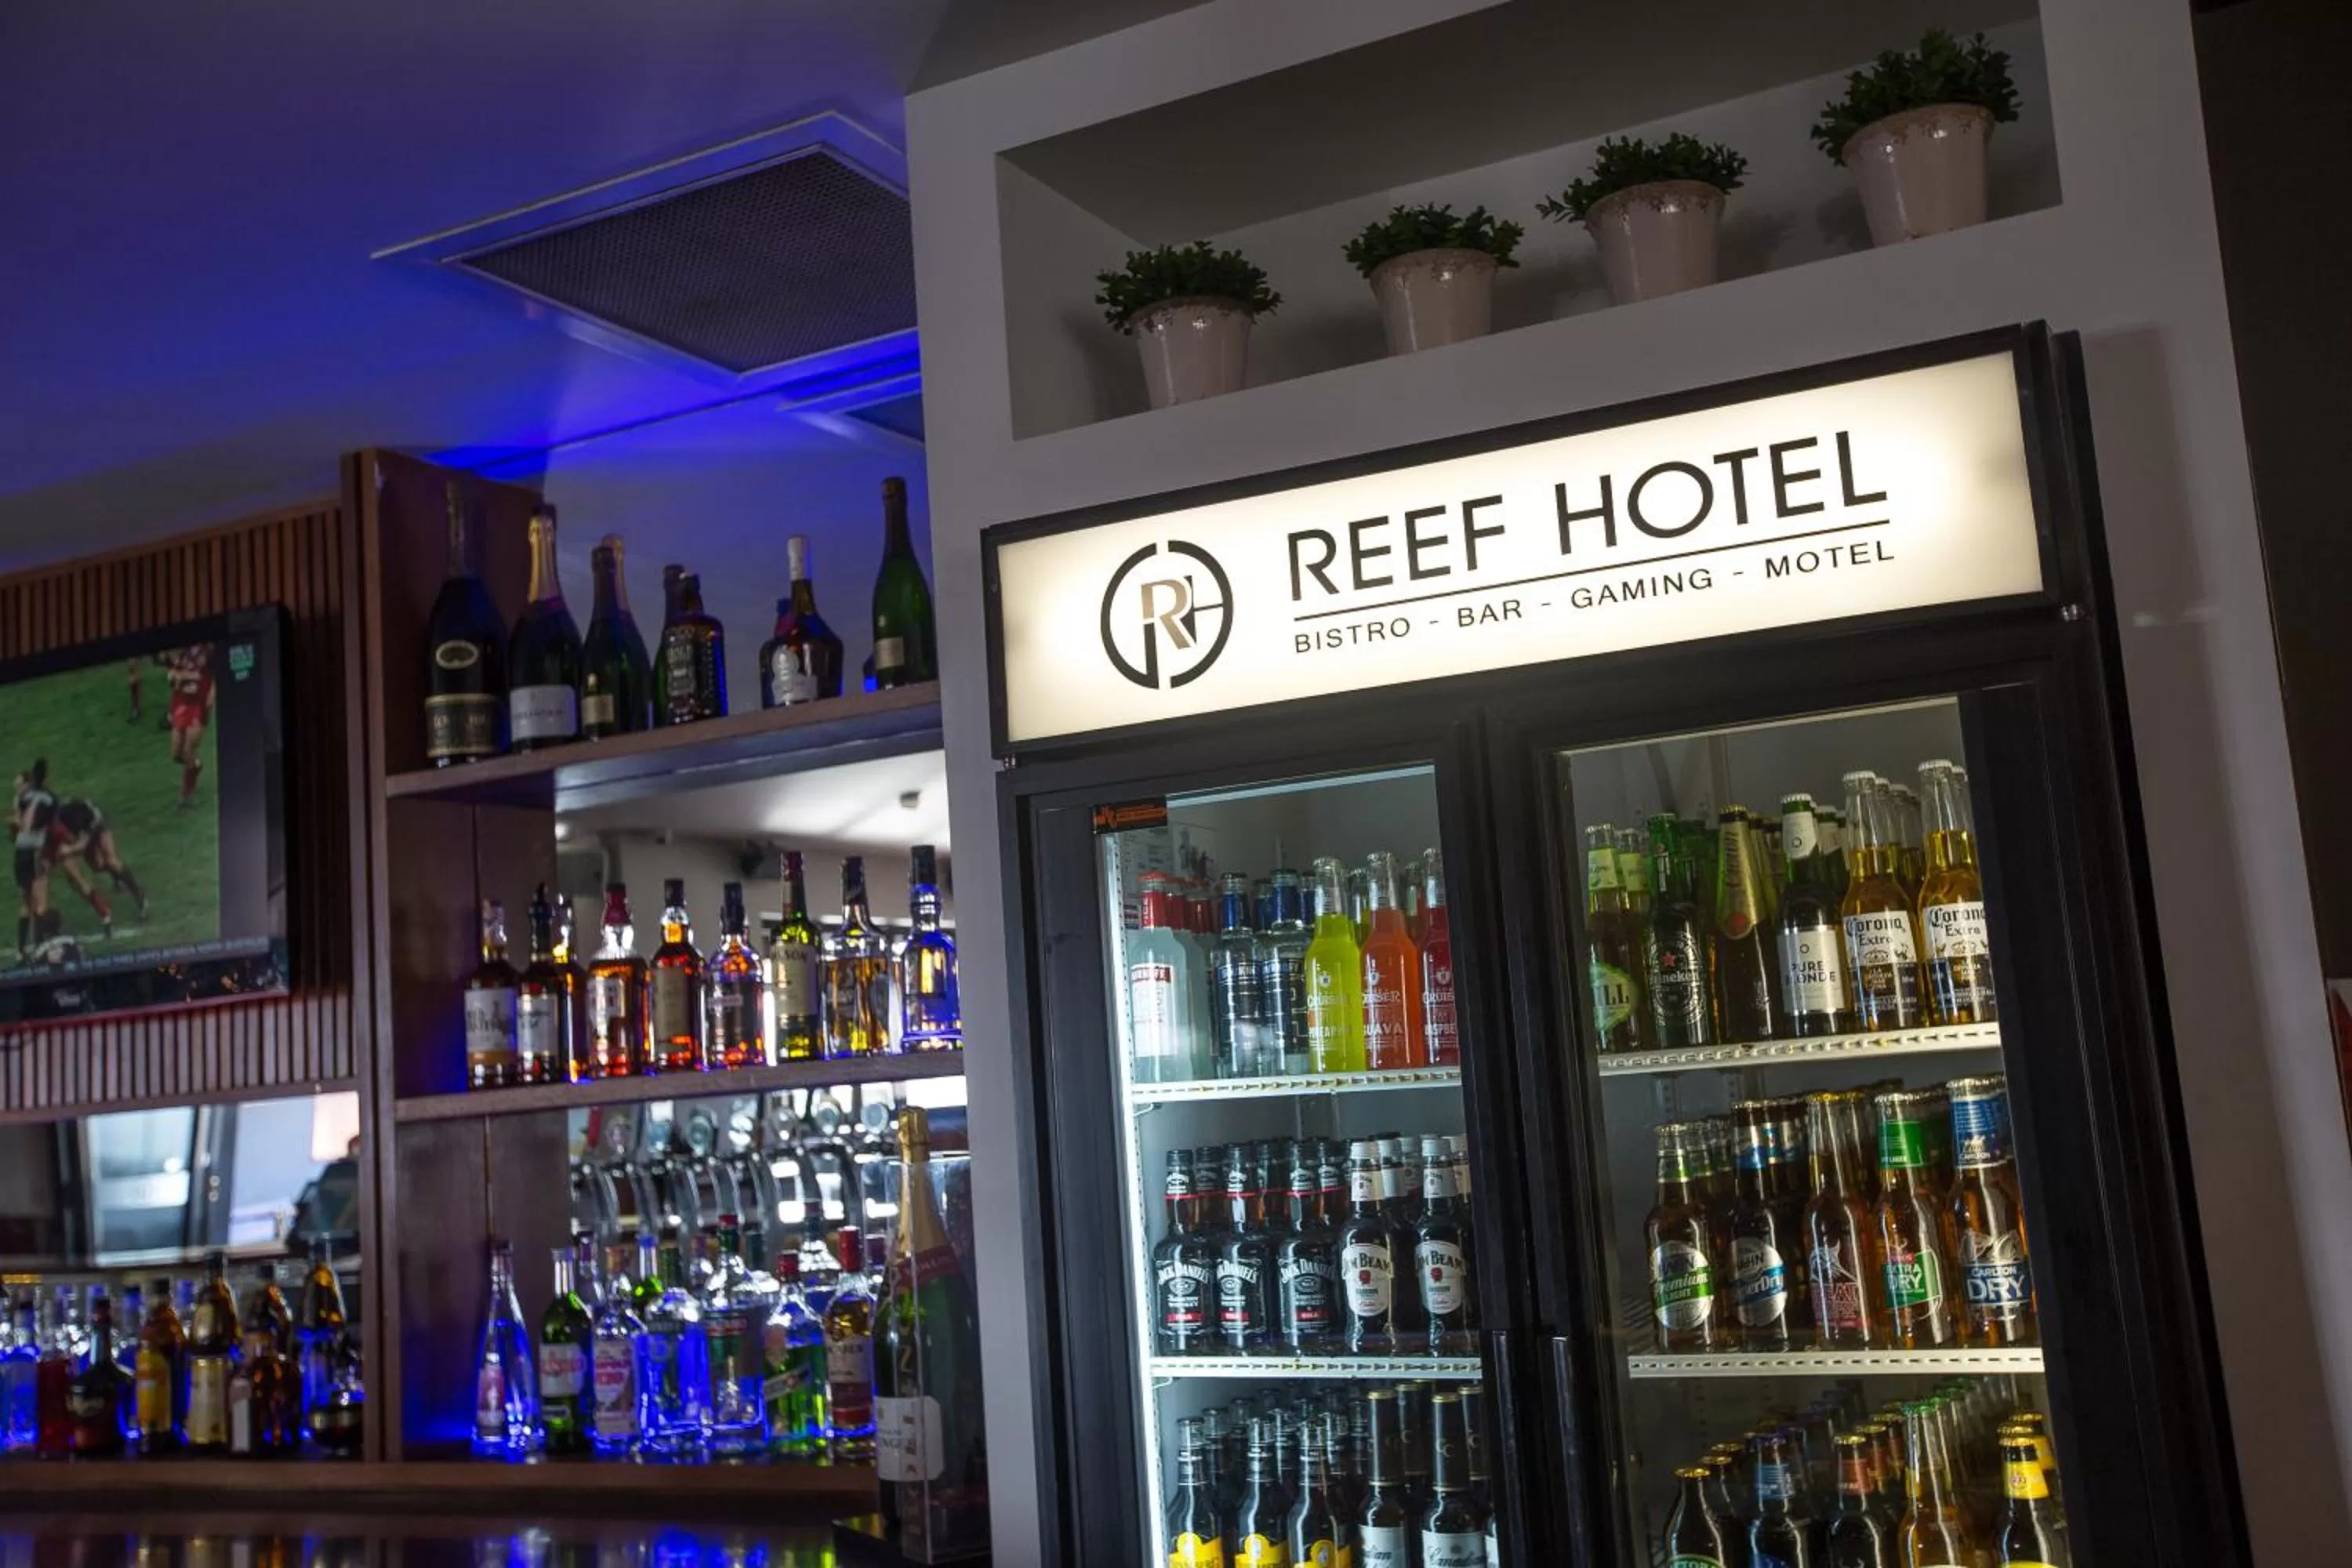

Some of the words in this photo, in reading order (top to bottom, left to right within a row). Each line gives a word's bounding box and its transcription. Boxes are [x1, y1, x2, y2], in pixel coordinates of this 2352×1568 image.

[1287, 494, 1505, 601] REEF
[1555, 430, 1887, 556] HOTEL
[1294, 617, 1410, 653] BISTRO
[1457, 600, 1522, 628] BAR
[1571, 568, 1712, 609] GAMING
[1765, 540, 1895, 579] MOTEL
[1363, 1022, 1403, 1036] UAVA
[1887, 1273, 1922, 1290] DRY
[1968, 1275, 2025, 1301] DRY
